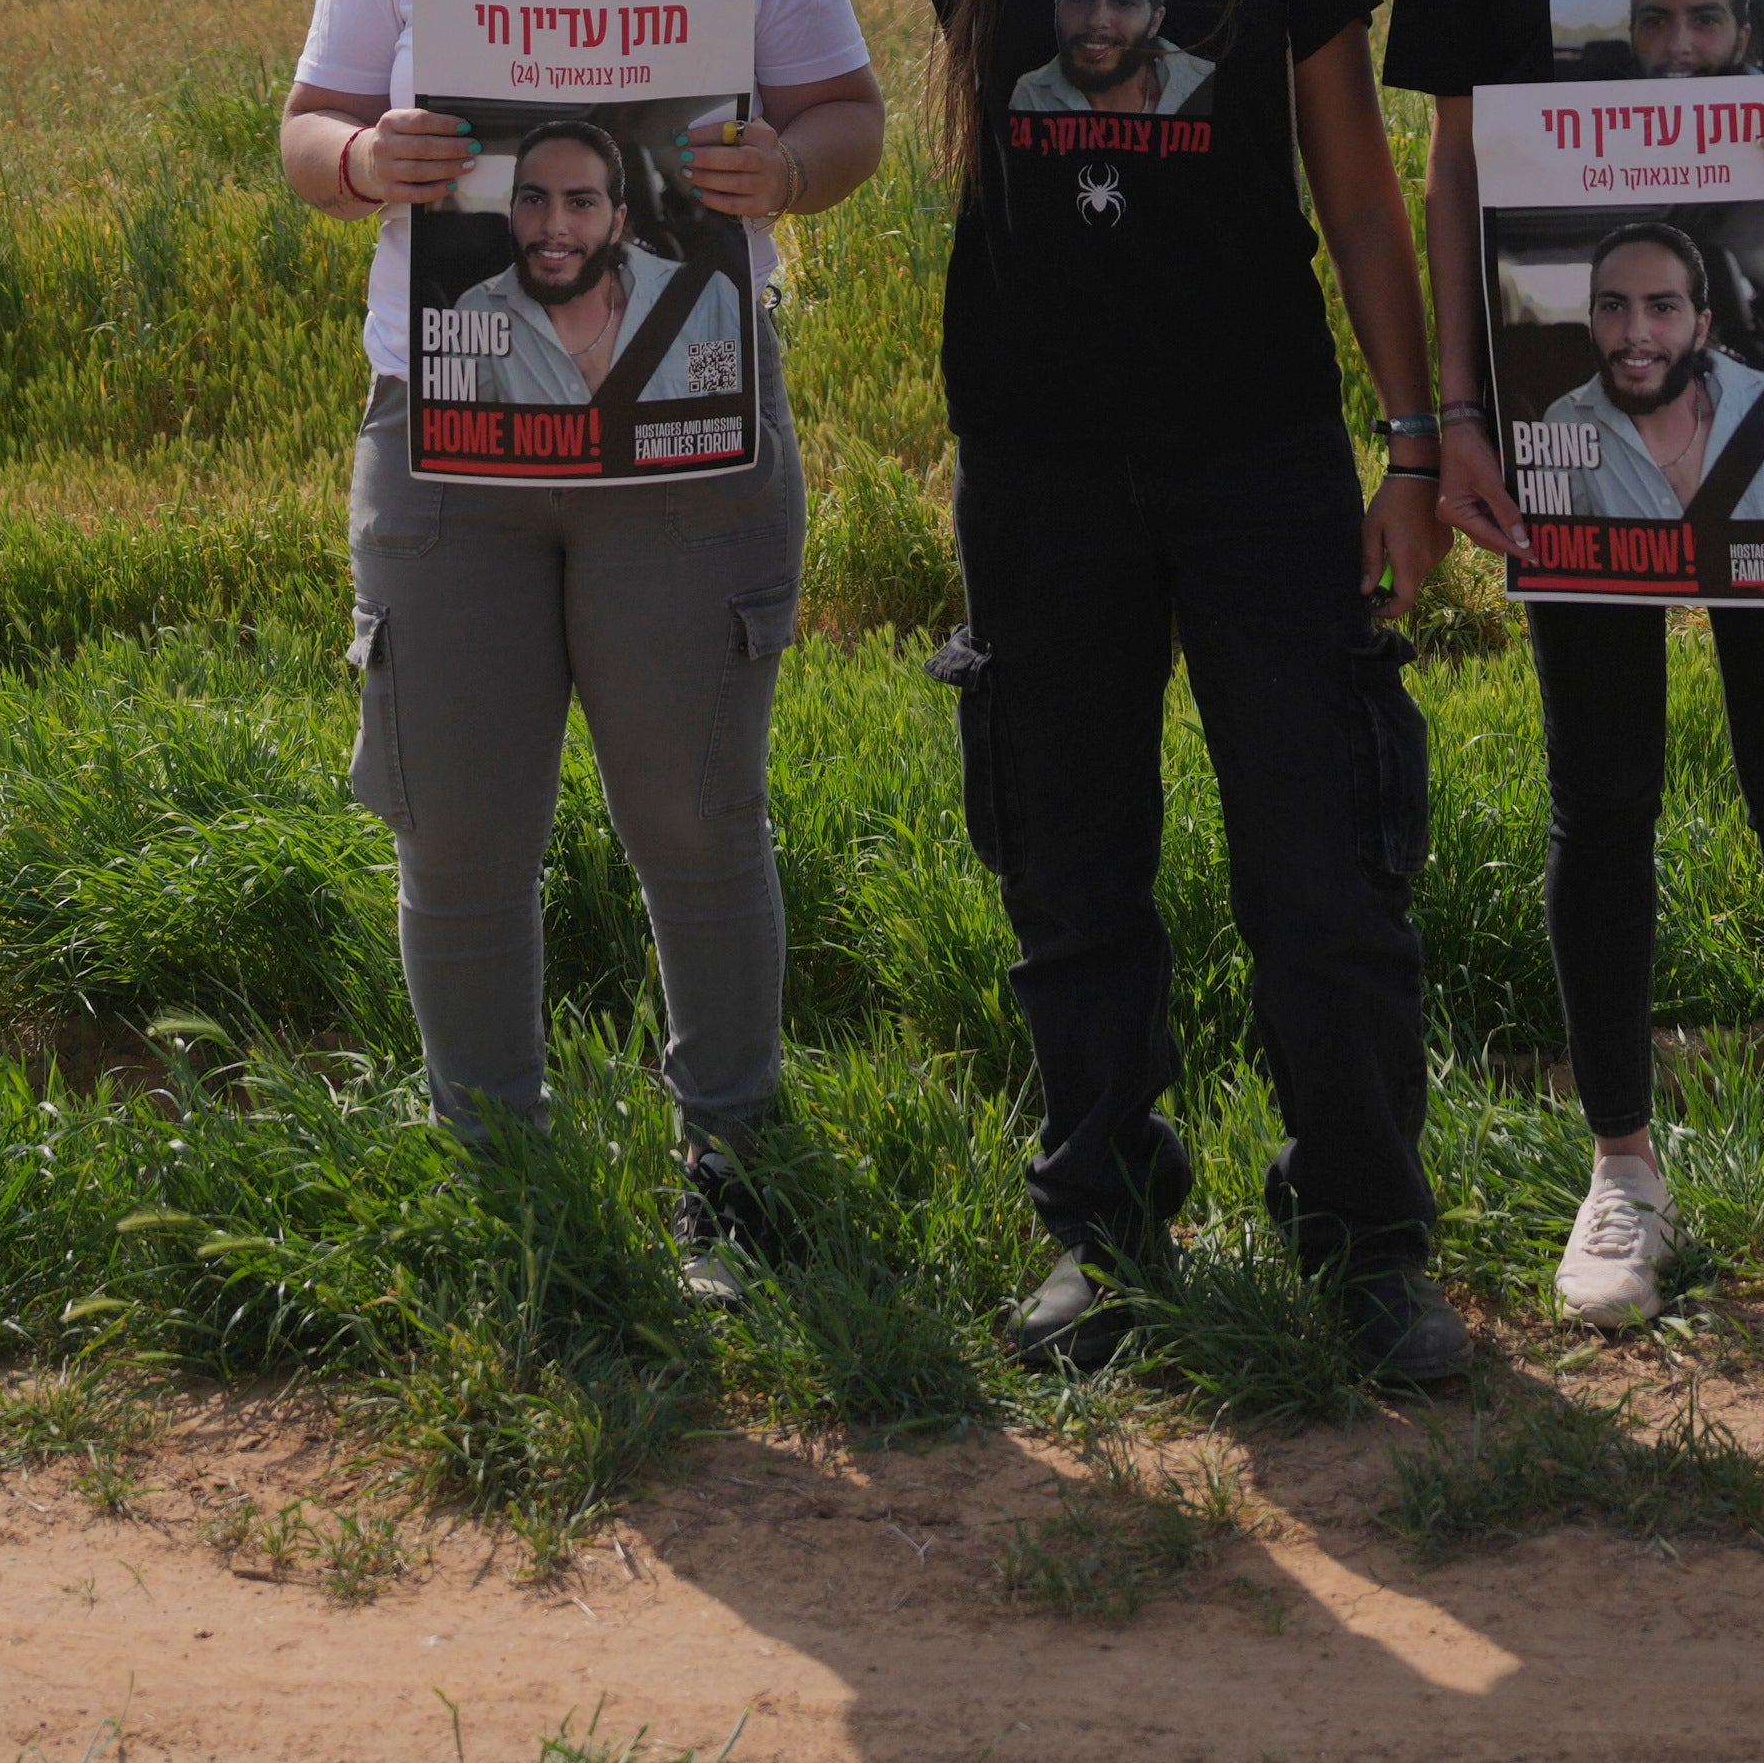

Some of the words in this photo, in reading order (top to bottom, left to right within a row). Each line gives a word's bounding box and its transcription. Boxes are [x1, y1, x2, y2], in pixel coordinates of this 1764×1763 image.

[475, 3, 510, 45] חי
[520, 6, 608, 55] עדיין
[618, 5, 688, 56] מתן
[510, 60, 541, 87] (24)
[619, 65, 651, 88] מתן
[1160, 121, 1212, 158] מתן
[1541, 108, 1581, 150] חי
[1591, 105, 1683, 158] עדיין
[1582, 164, 1615, 191] (24)
[1696, 164, 1731, 189] מתן
[422, 307, 510, 356] BRING
[422, 356, 477, 402] HIM
[422, 408, 505, 456] HOME
[513, 407, 602, 458] NOW!
[635, 422, 682, 439] HOSTAGES
[683, 420, 702, 435] AND
[703, 415, 742, 432] MISSING
[636, 436, 694, 460] FAMILIES
[697, 431, 742, 454] FORUM
[1512, 420, 1601, 470] BRING
[1517, 469, 1572, 516] HIM
[1608, 522, 1698, 575] NOW!
